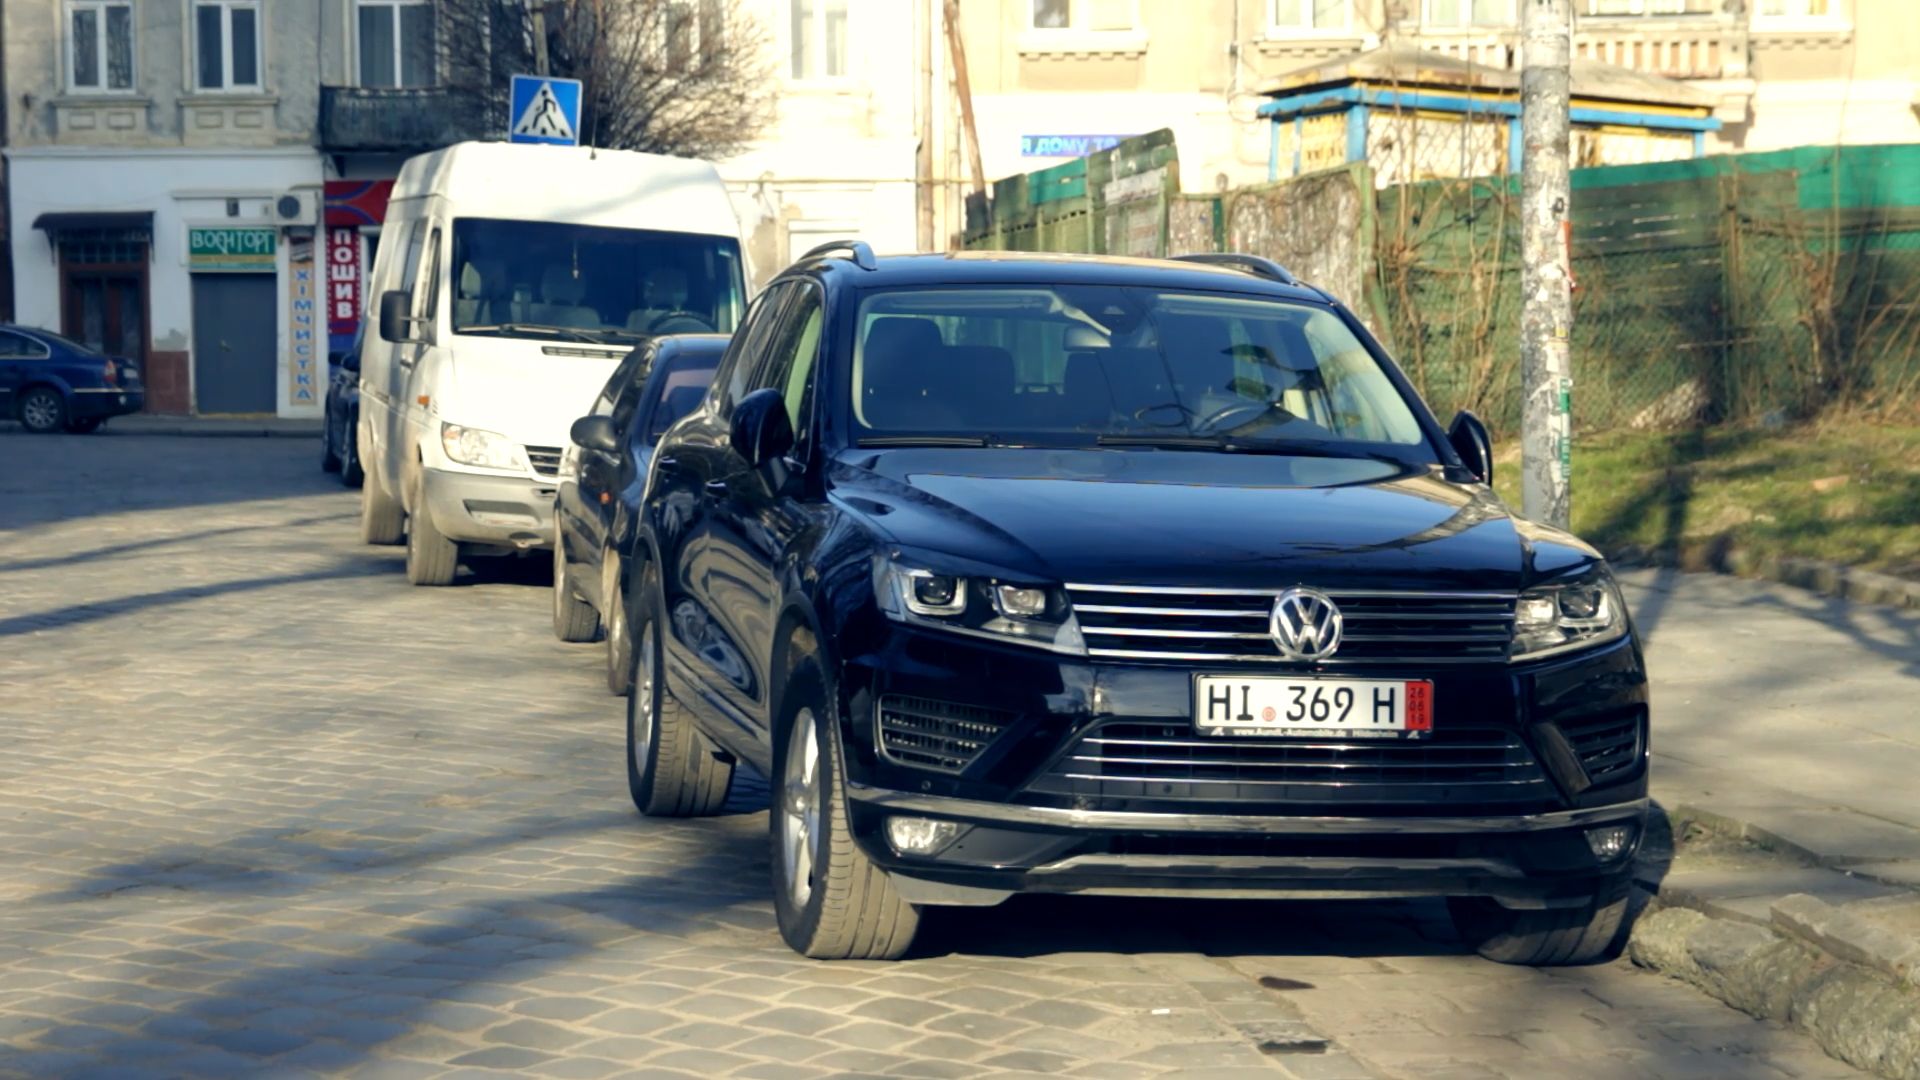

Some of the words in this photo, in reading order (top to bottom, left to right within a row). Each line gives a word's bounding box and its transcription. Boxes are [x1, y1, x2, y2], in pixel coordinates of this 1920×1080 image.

[1034, 137, 1089, 155] ДОМУ
[332, 230, 355, 318] ПОШИВ
[294, 270, 313, 400] ХІМЧИСТКА
[1208, 684, 1254, 722] HI
[1286, 686, 1355, 723] 369
[1373, 687, 1395, 724] H
